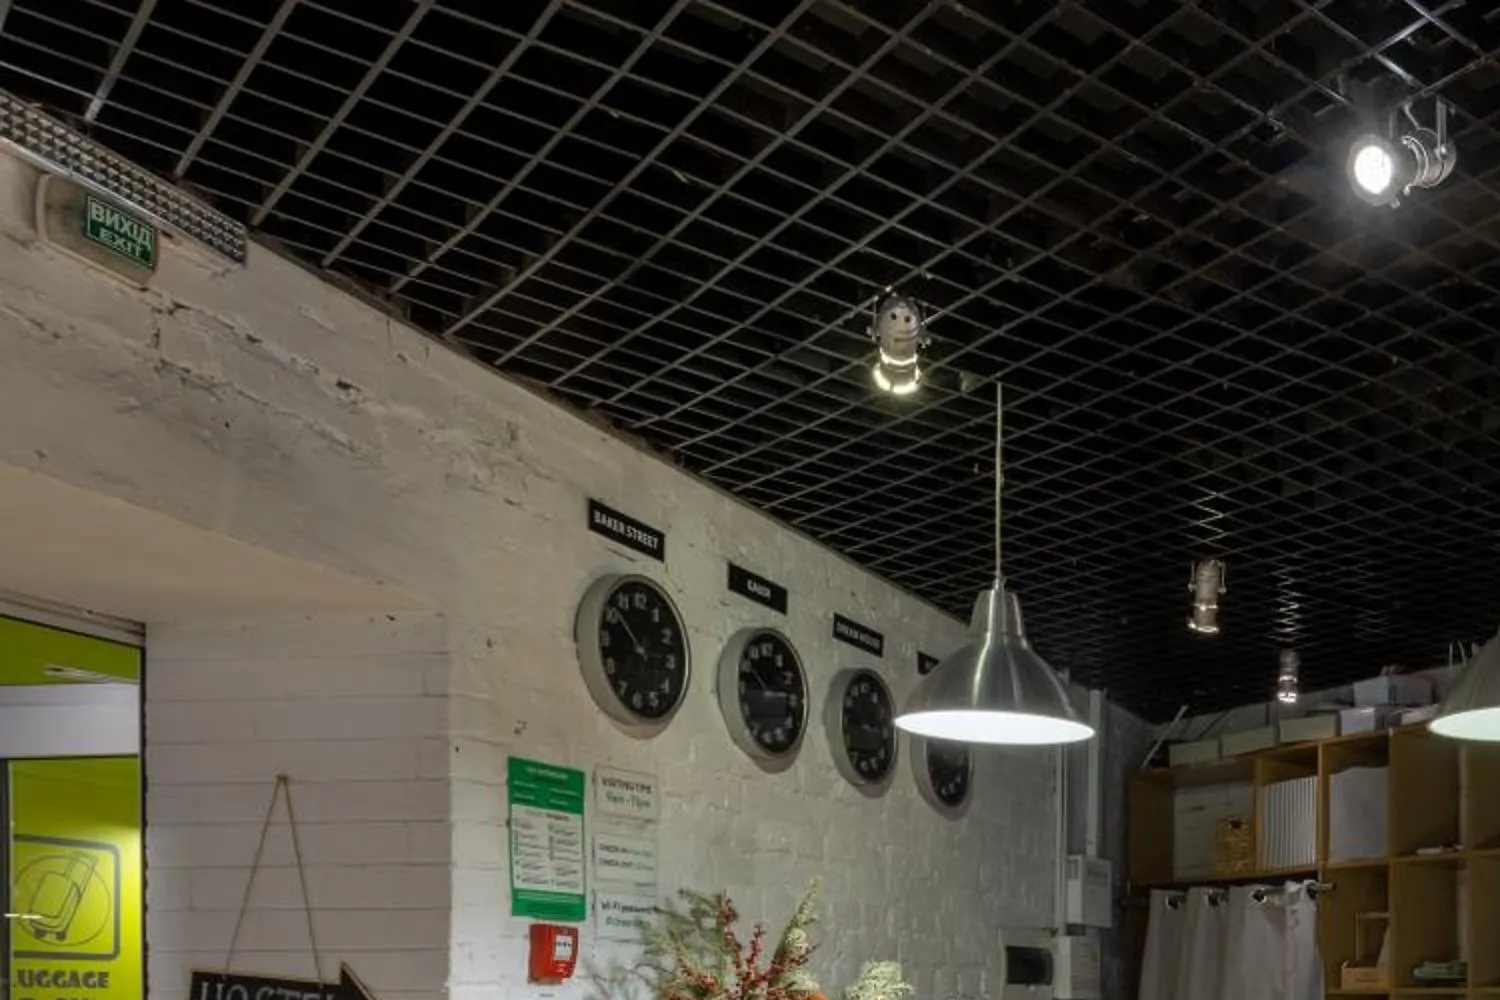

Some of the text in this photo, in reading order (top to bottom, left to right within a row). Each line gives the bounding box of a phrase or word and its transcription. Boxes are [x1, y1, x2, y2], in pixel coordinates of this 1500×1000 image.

[90, 201, 152, 250] ВИХІД
[99, 227, 145, 258] EXIT
[626, 523, 659, 549] STREET
[652, 607, 659, 623] 1
[661, 628, 672, 645] 2
[14, 969, 110, 988] UGGAGE
